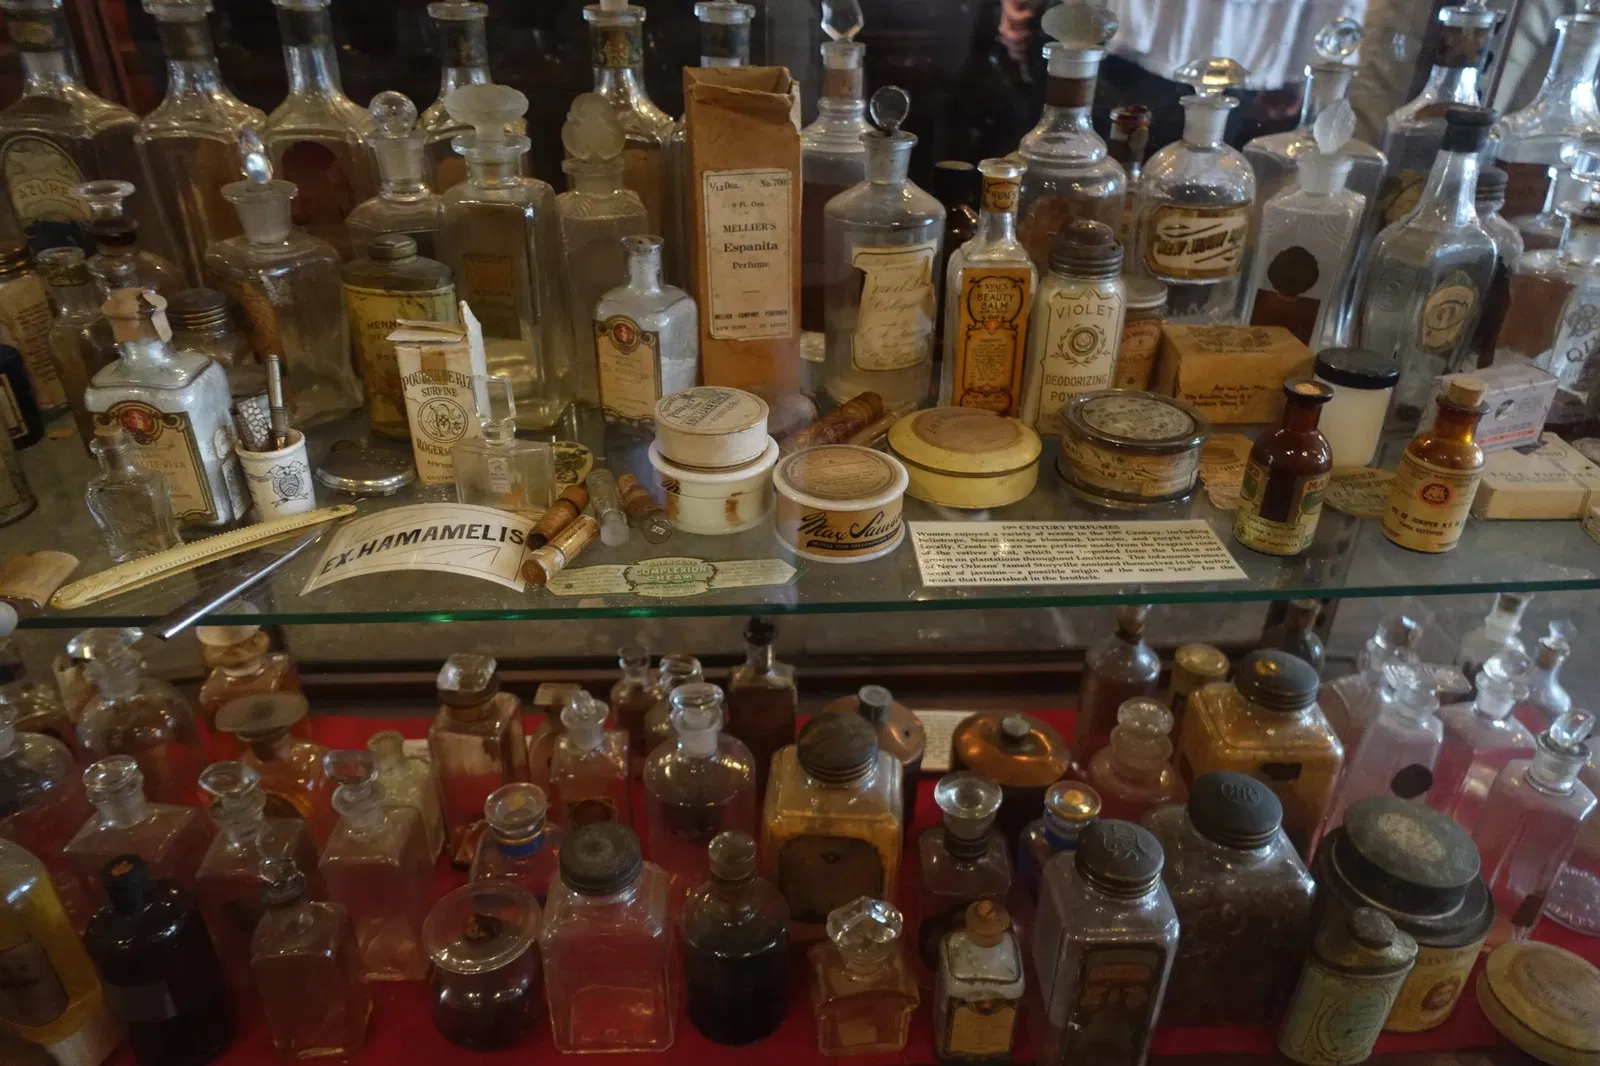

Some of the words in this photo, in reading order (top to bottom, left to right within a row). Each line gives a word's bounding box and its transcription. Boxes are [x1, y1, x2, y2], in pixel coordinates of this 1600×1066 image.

[723, 222, 776, 233] MELLIER'S
[724, 241, 778, 254] Espanita
[733, 261, 769, 269] Perfume
[977, 293, 1014, 302] BEAUTY
[980, 302, 1008, 310] BALM
[1055, 304, 1115, 319] VIOLET
[367, 321, 401, 329] MENN
[421, 387, 458, 397] SURFINE
[1051, 391, 1077, 402] POW
[636, 566, 707, 575] COMPLEXION
